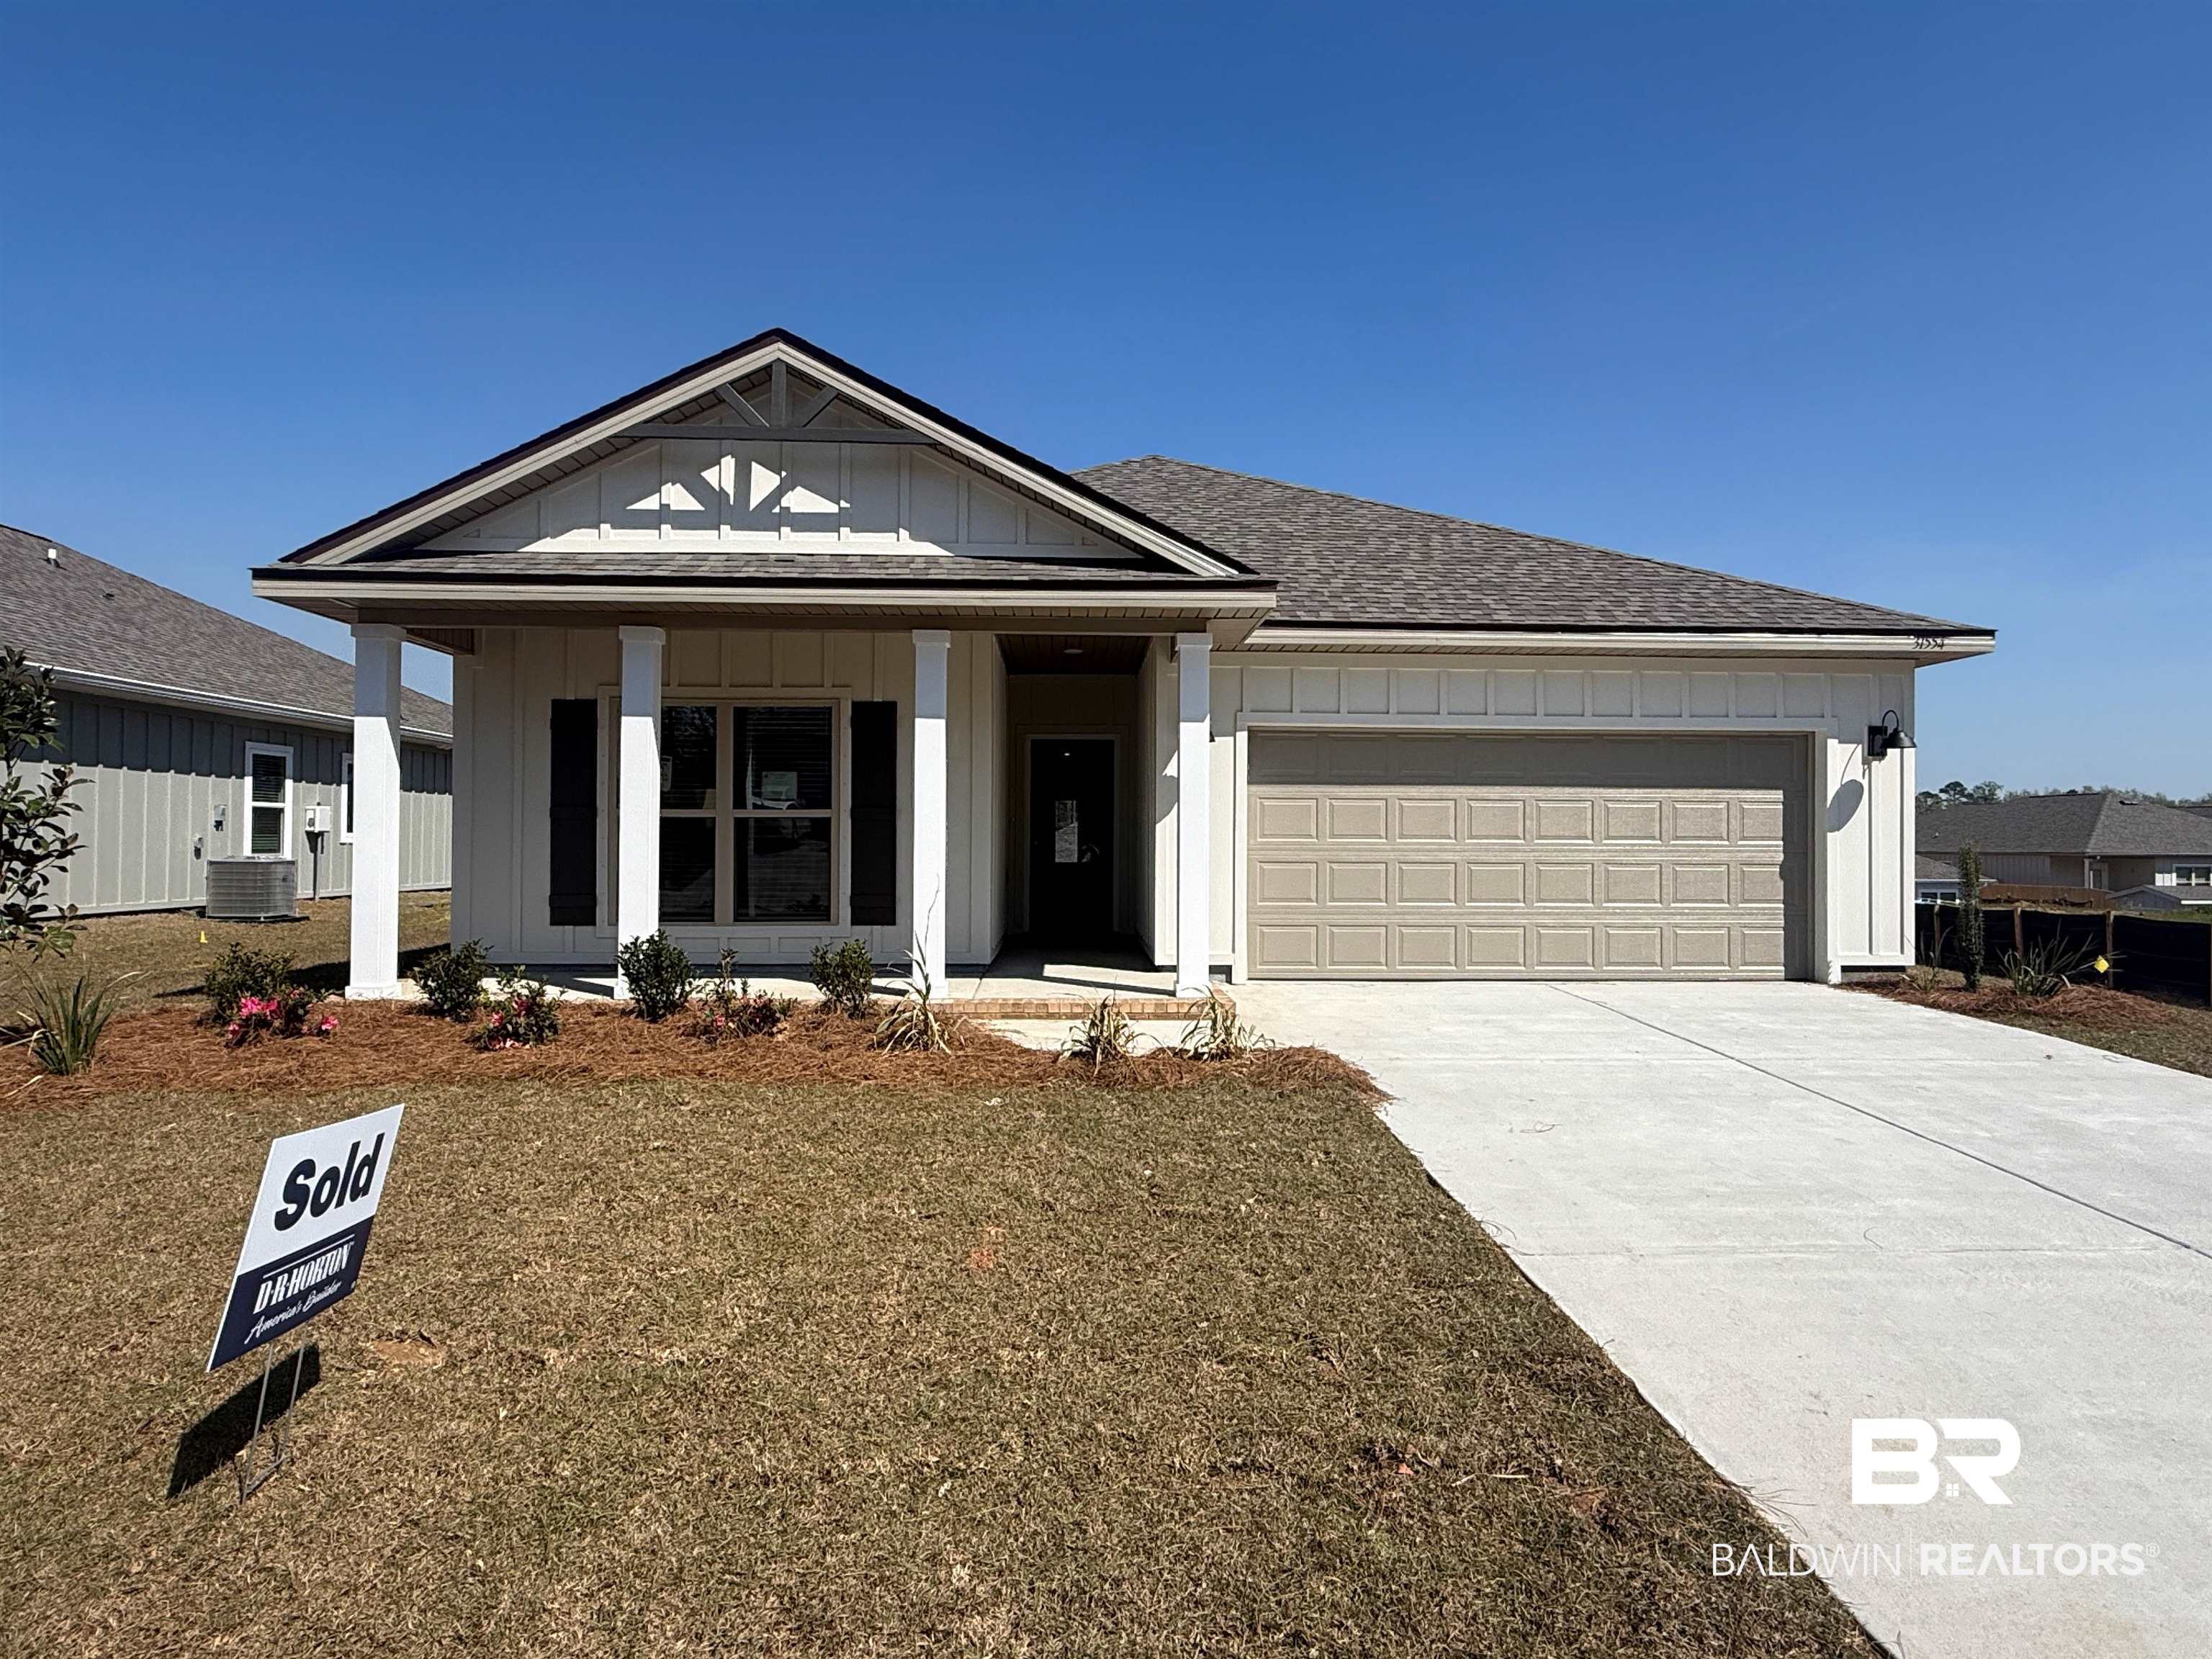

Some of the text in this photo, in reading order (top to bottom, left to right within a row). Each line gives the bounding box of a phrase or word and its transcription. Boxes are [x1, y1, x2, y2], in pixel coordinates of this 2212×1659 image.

[274, 1132, 385, 1232] Sold
[243, 1279, 342, 1344] America's Builder
